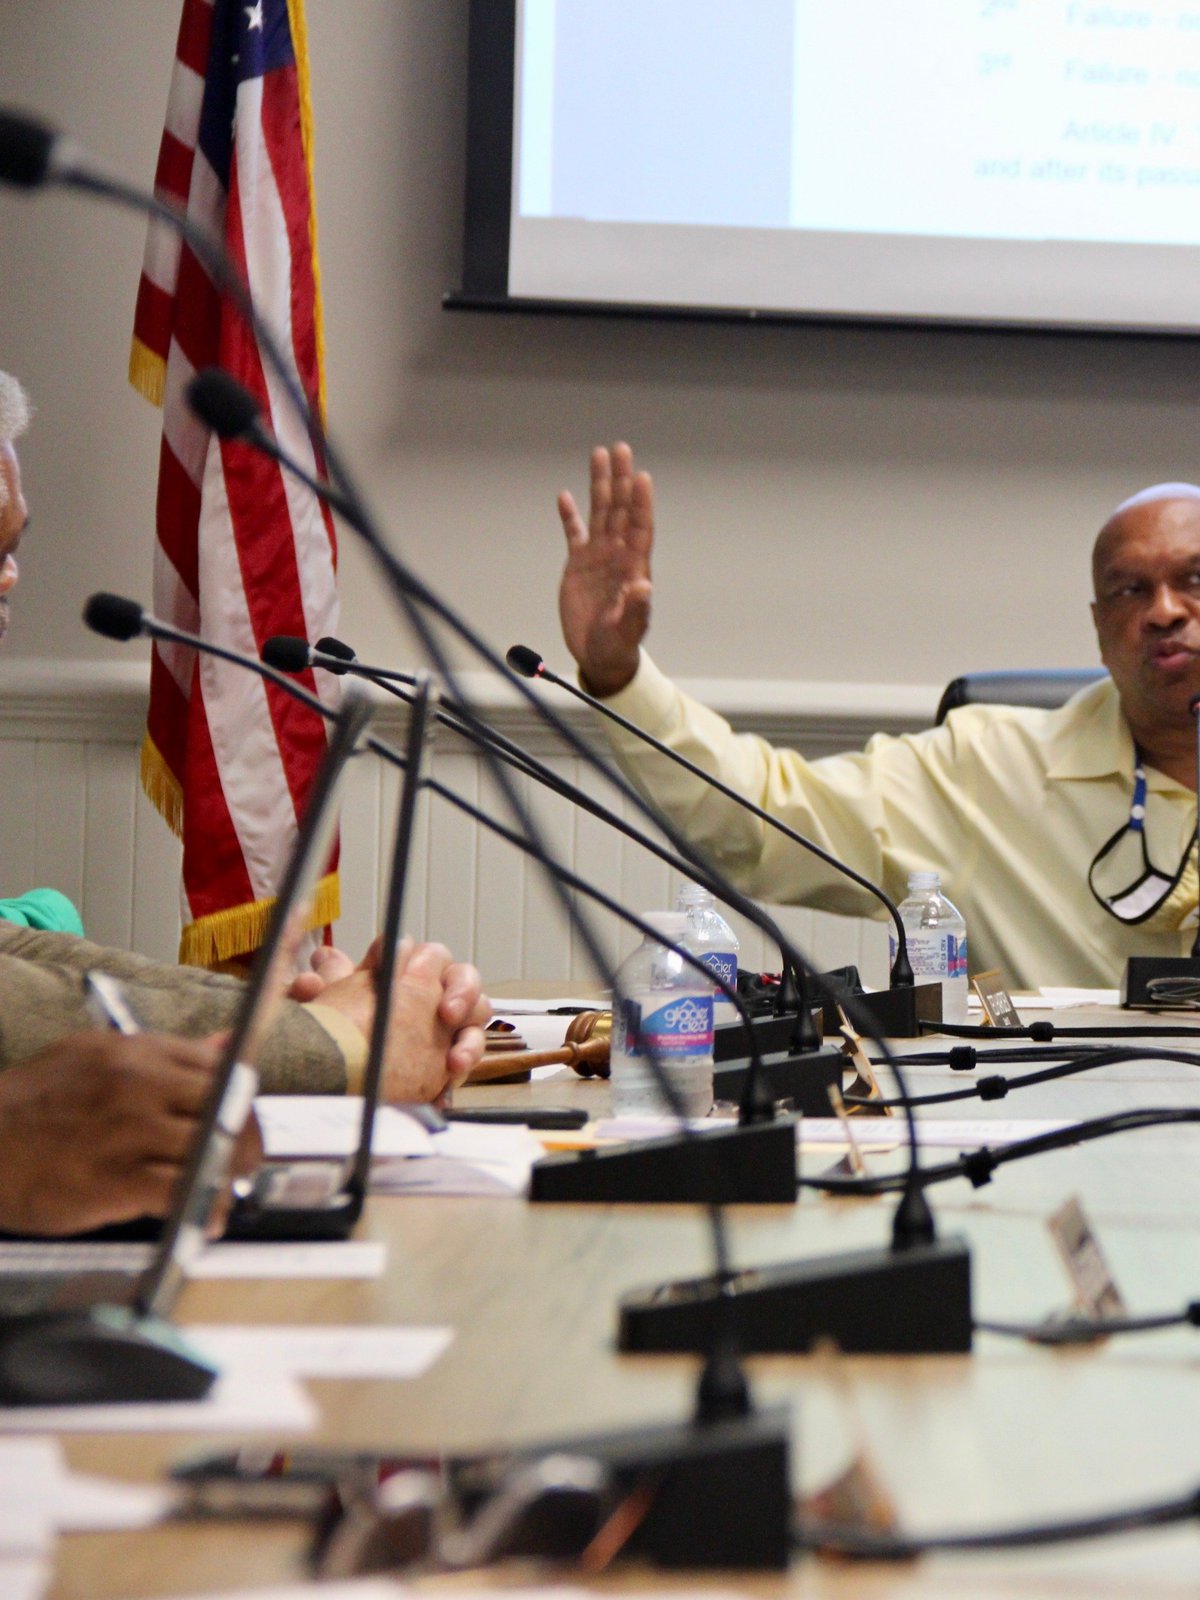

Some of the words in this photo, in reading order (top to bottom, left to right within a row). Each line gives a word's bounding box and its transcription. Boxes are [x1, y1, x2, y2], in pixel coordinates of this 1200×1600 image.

[1065, 2, 1152, 29] Failure
[1063, 58, 1150, 85] Failure
[1061, 120, 1142, 145] Article
[974, 155, 1021, 180] and
[1029, 156, 1088, 182] after
[1098, 162, 1127, 183] its
[664, 1006, 709, 1028] glacier
[679, 1019, 709, 1033] clear
